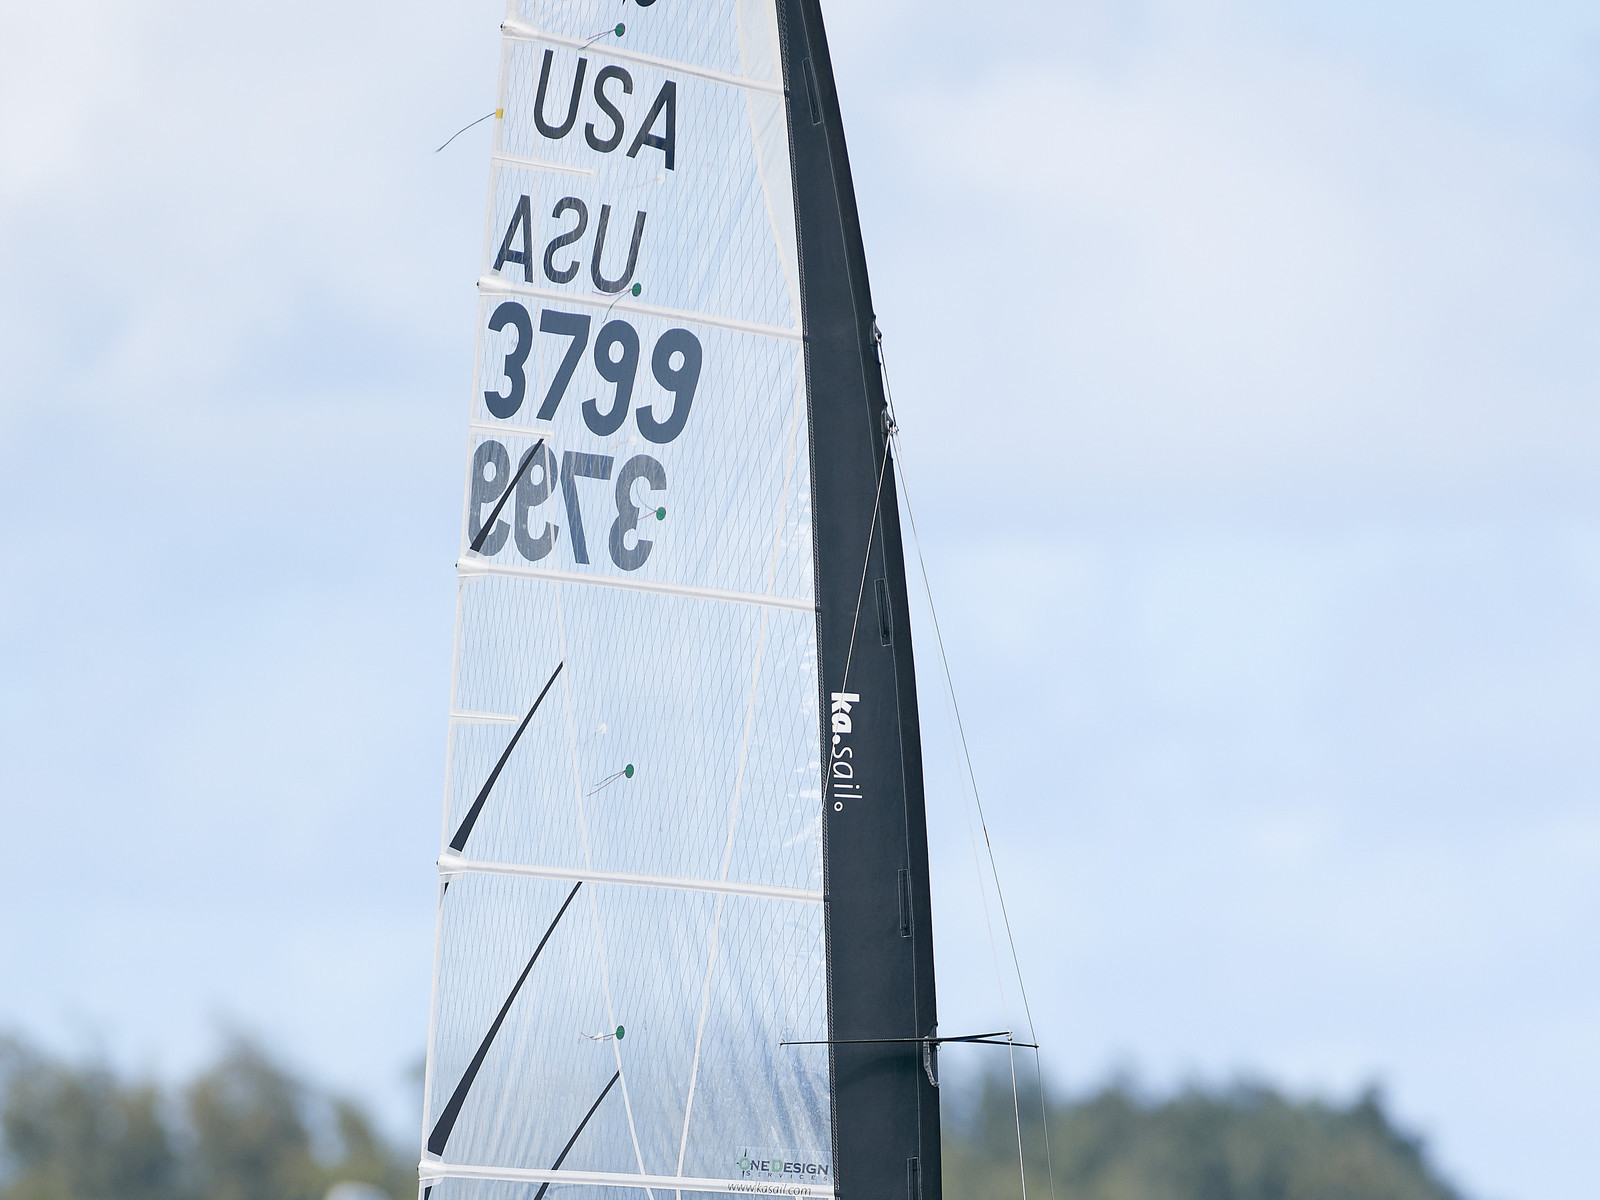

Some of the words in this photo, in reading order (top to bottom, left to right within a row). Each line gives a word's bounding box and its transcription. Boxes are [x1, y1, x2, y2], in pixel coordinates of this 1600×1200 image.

[533, 49, 677, 171] USA
[484, 301, 703, 444] 3799
[727, 1183, 812, 1196] wwwkasail.com
